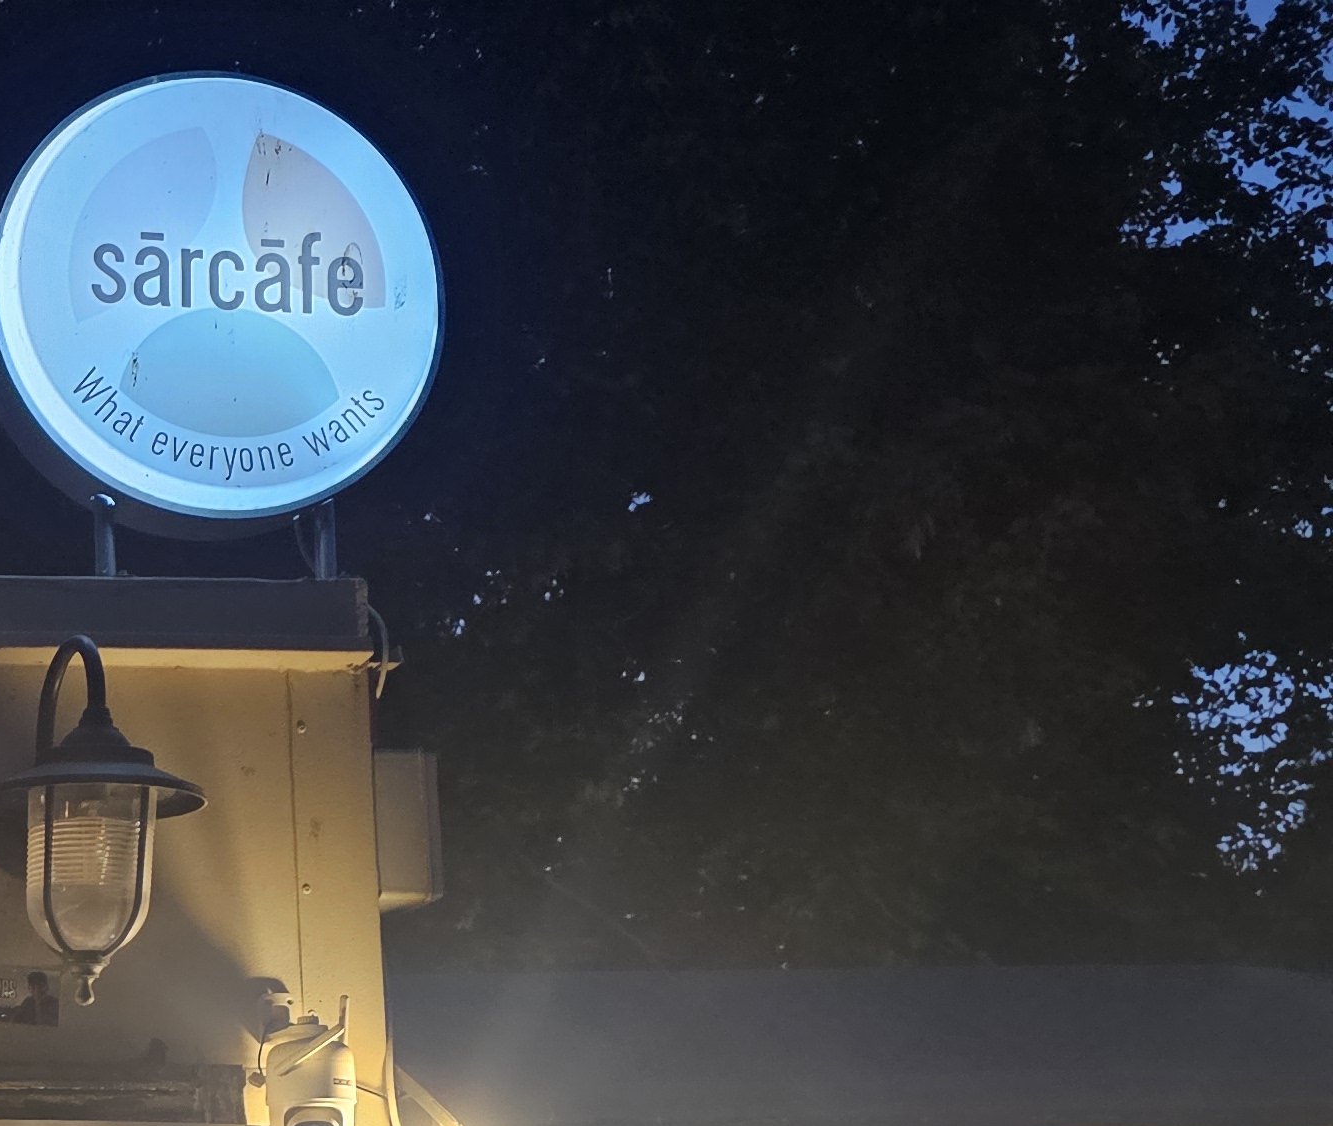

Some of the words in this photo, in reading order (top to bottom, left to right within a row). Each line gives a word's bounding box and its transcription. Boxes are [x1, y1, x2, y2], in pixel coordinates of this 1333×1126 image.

[73, 366, 145, 444] What
[151, 430, 295, 481] everyone
[302, 388, 386, 458] wants
